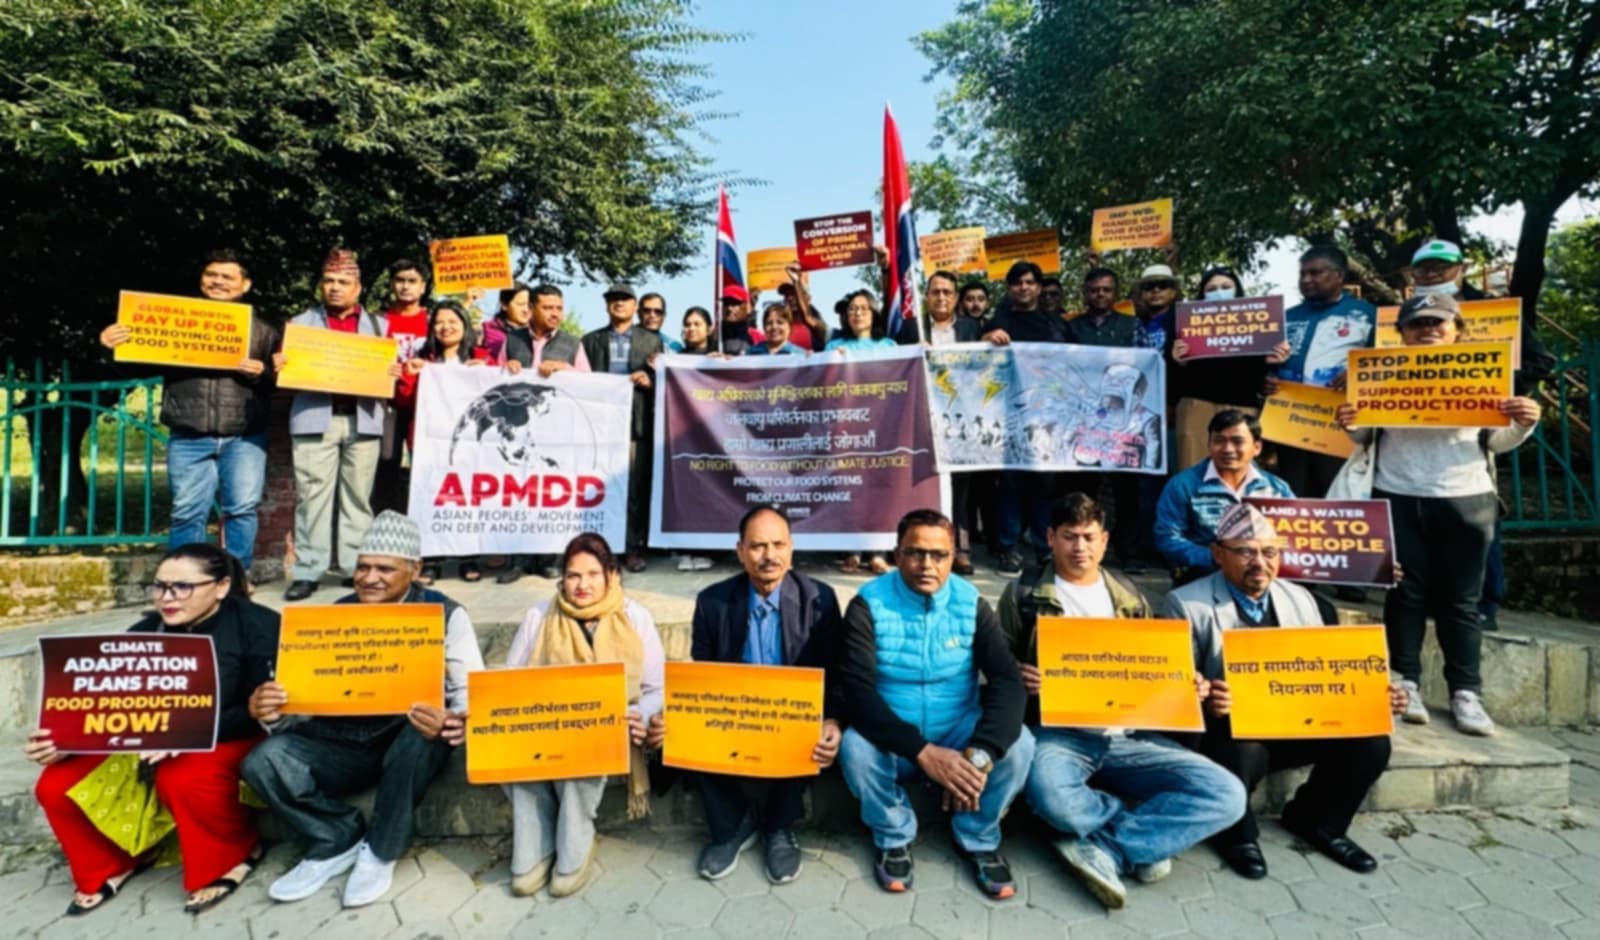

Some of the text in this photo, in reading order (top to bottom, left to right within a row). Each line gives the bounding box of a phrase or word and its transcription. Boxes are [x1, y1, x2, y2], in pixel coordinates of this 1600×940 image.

[802, 223, 867, 239] CONVERSION
[1128, 223, 1160, 233] FOOD
[811, 238, 825, 246] OF
[438, 261, 505, 273] PLANTATIONS
[439, 274, 457, 283] FOR
[138, 303, 186, 315] GLOBAL
[1192, 306, 1218, 314] LAND
[1230, 302, 1267, 311] WATER
[132, 313, 238, 333] PAY UP FOR
[1190, 310, 1270, 326] BACK TO
[126, 325, 243, 344] DESTROYING OUR
[1182, 322, 1279, 337] THE PEOPLE
[173, 340, 241, 354] SYSTEMS!
[1206, 335, 1254, 347] NOW!
[1357, 351, 1503, 368] STOP IMPORT
[1357, 367, 1503, 382] DEPENDENCY!
[1357, 385, 1500, 397] SUPPORT LOCAL
[1357, 399, 1504, 411] PRODUCTION!
[689, 460, 704, 470] NO
[705, 460, 734, 471] RIGHT
[750, 460, 777, 471] FOOD
[778, 459, 824, 470] WITHOUT
[826, 457, 866, 470] CLIMATE
[733, 475, 863, 487] PROTECT OUR FOOD SYSTEMS
[433, 472, 606, 508] APMDD
[746, 491, 852, 503] FROM CLIMATE CHANGE
[432, 510, 473, 521] ASIAN
[537, 511, 605, 521] MOVEMENT
[1261, 506, 1365, 518] LAND & WATER
[431, 522, 605, 534] ON DEBT AND DEVELOPMENT
[1332, 520, 1370, 535] TO
[1295, 537, 1386, 553] PEOPLE
[1283, 552, 1348, 568] NOW!
[100, 641, 164, 653] CLIMATE
[64, 656, 198, 672] ADAPTATION
[1228, 661, 1260, 674] खाद्य
[1264, 657, 1324, 673] सामग्रीको
[73, 675, 188, 692] PLANS FOR
[1327, 683, 1347, 695] गर
[45, 695, 213, 711] FOOD PRODUCTION
[84, 711, 170, 734] NOW!
